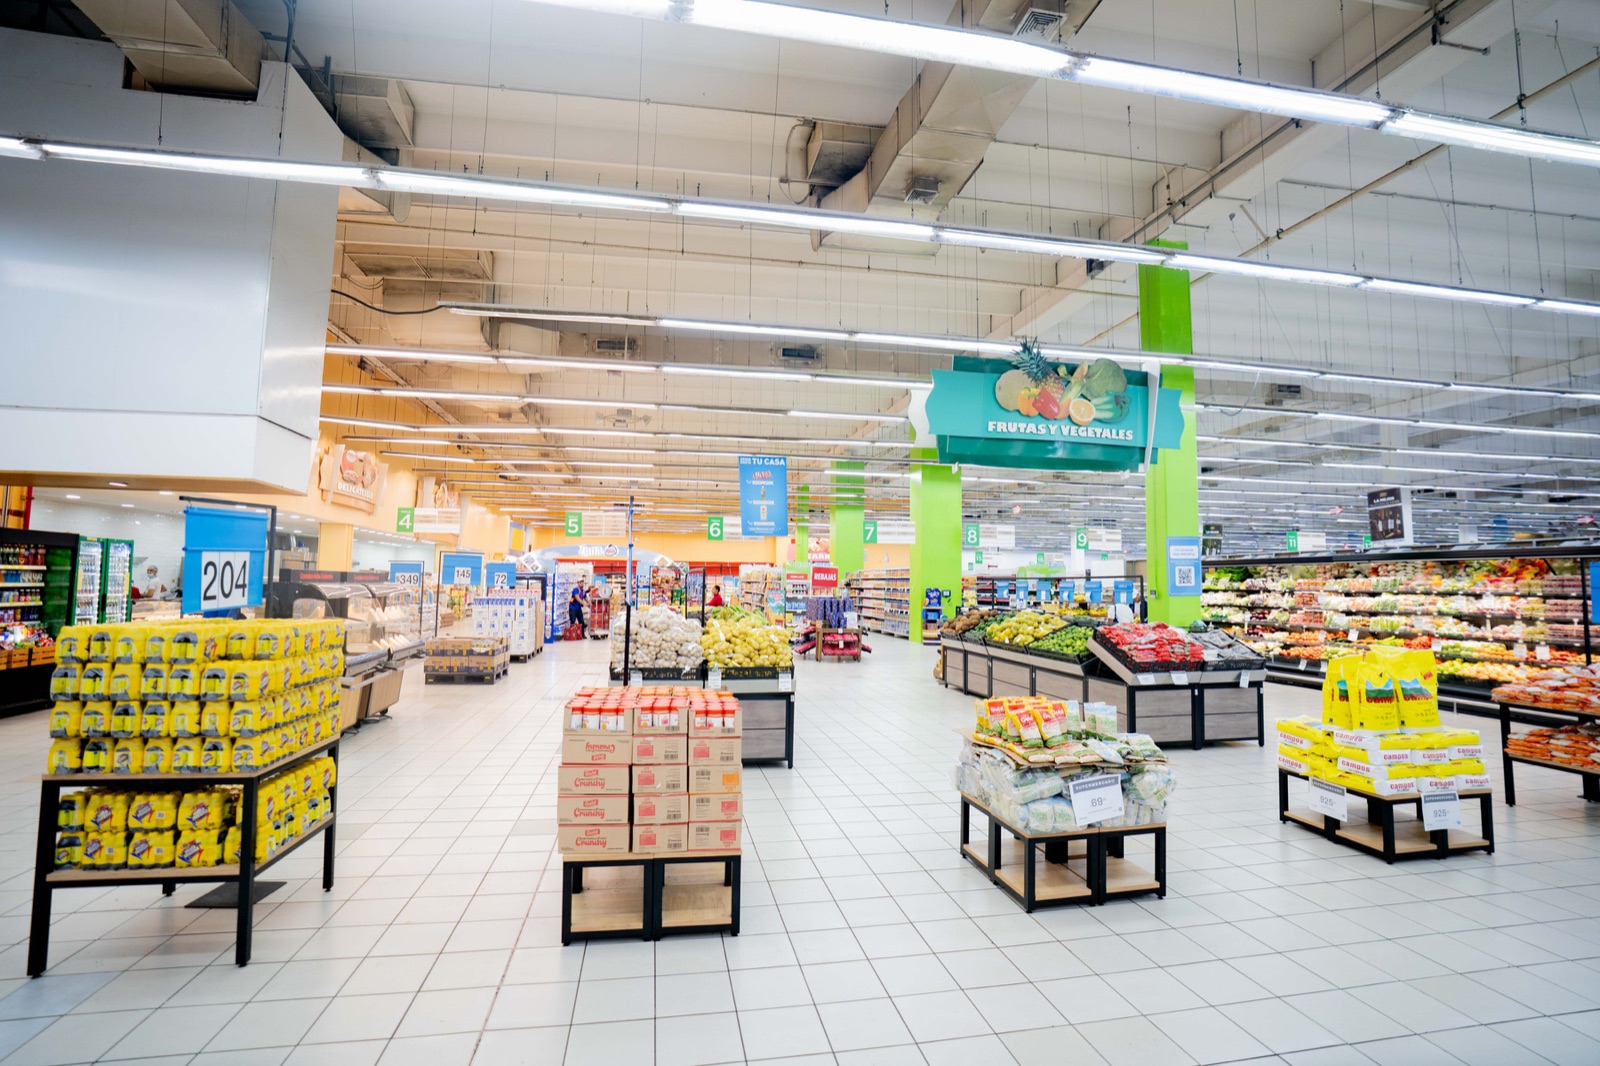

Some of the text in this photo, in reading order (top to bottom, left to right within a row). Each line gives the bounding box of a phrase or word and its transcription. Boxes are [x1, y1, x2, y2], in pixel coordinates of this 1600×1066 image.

[987, 421, 1134, 441] FRUTAS Y VEGETALES
[752, 457, 763, 465] TU
[764, 457, 786, 466] CASA
[398, 513, 412, 529] 4
[567, 518, 579, 534] 5
[709, 522, 721, 537] 6
[864, 526, 875, 541] 7
[967, 529, 978, 544] 8
[1077, 533, 1087, 547] 9
[1288, 538, 1297, 548] 11
[456, 569, 471, 578] 145
[494, 573, 507, 584] 72
[203, 560, 247, 601] 204
[574, 777, 605, 789] Crunchy
[1320, 795, 1333, 806] 925
[573, 807, 605, 819] Crunchy
[1433, 809, 1447, 817] 925
[575, 837, 607, 848] Crunchy
